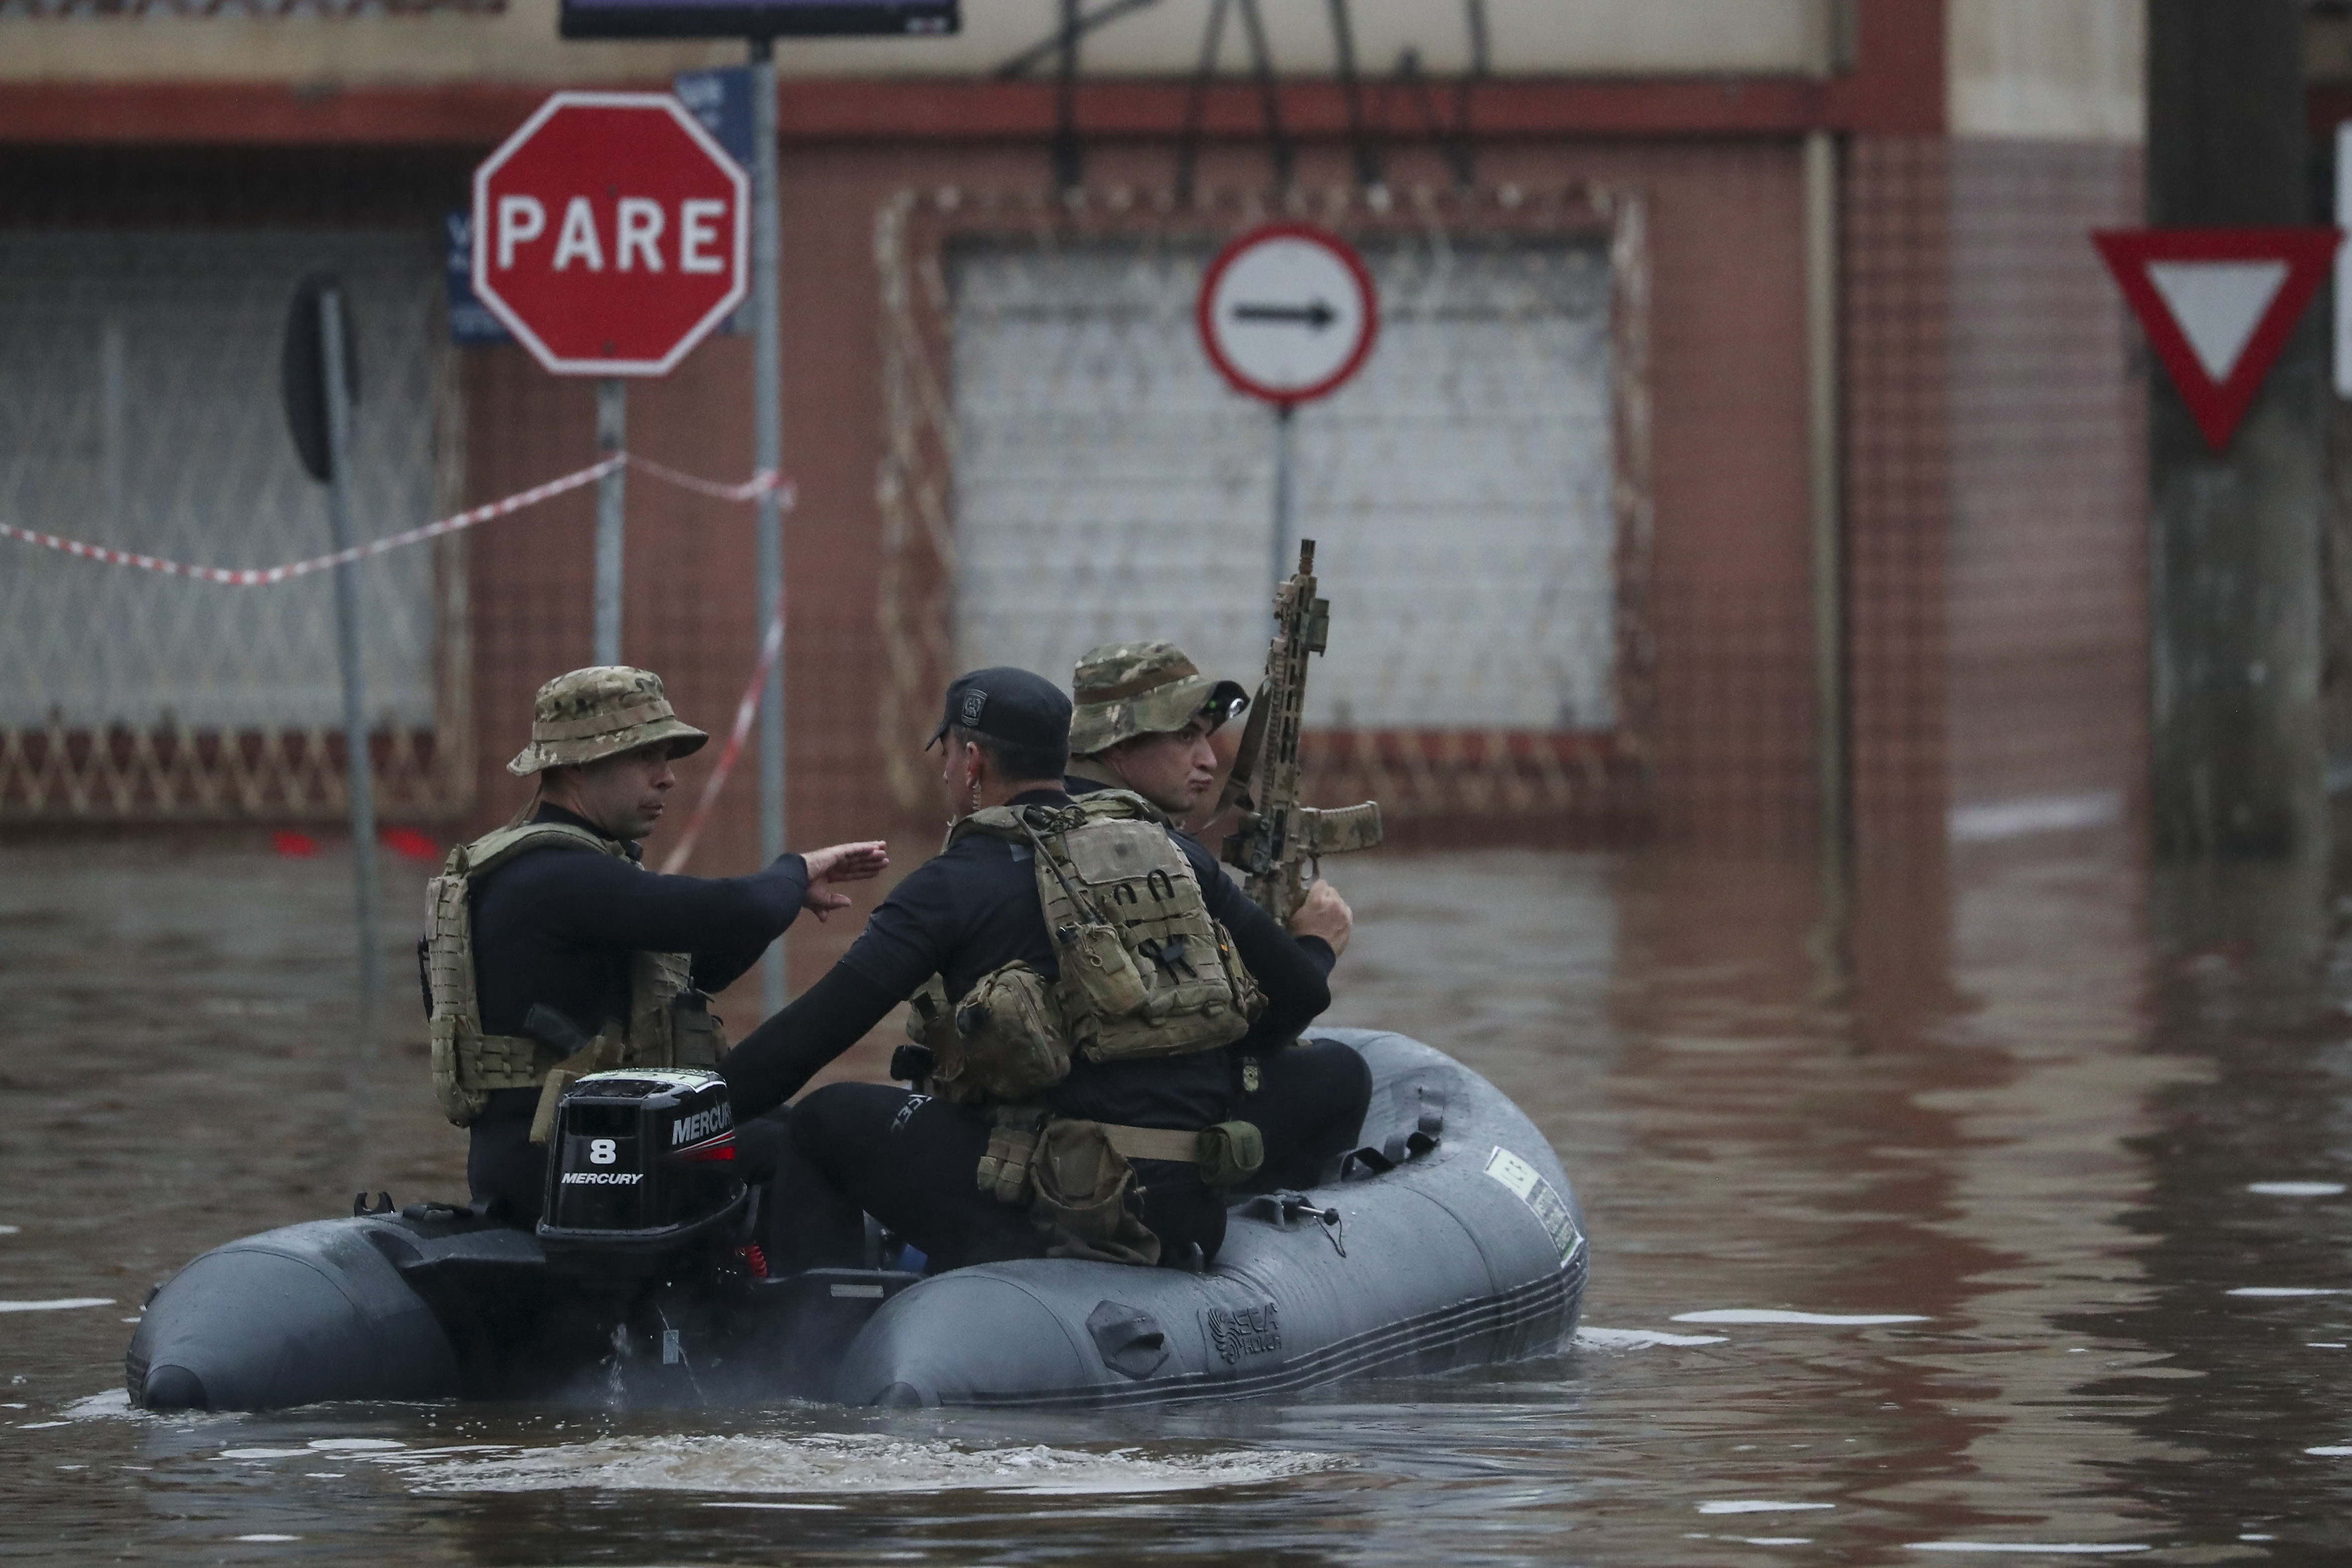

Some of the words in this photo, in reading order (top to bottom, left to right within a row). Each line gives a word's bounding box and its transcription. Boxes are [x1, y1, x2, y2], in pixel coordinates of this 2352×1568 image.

[499, 196, 725, 272] PARE
[672, 1101, 732, 1145] MERCUR
[590, 1139, 616, 1165] 8
[561, 1173, 644, 1184] MERCURY
